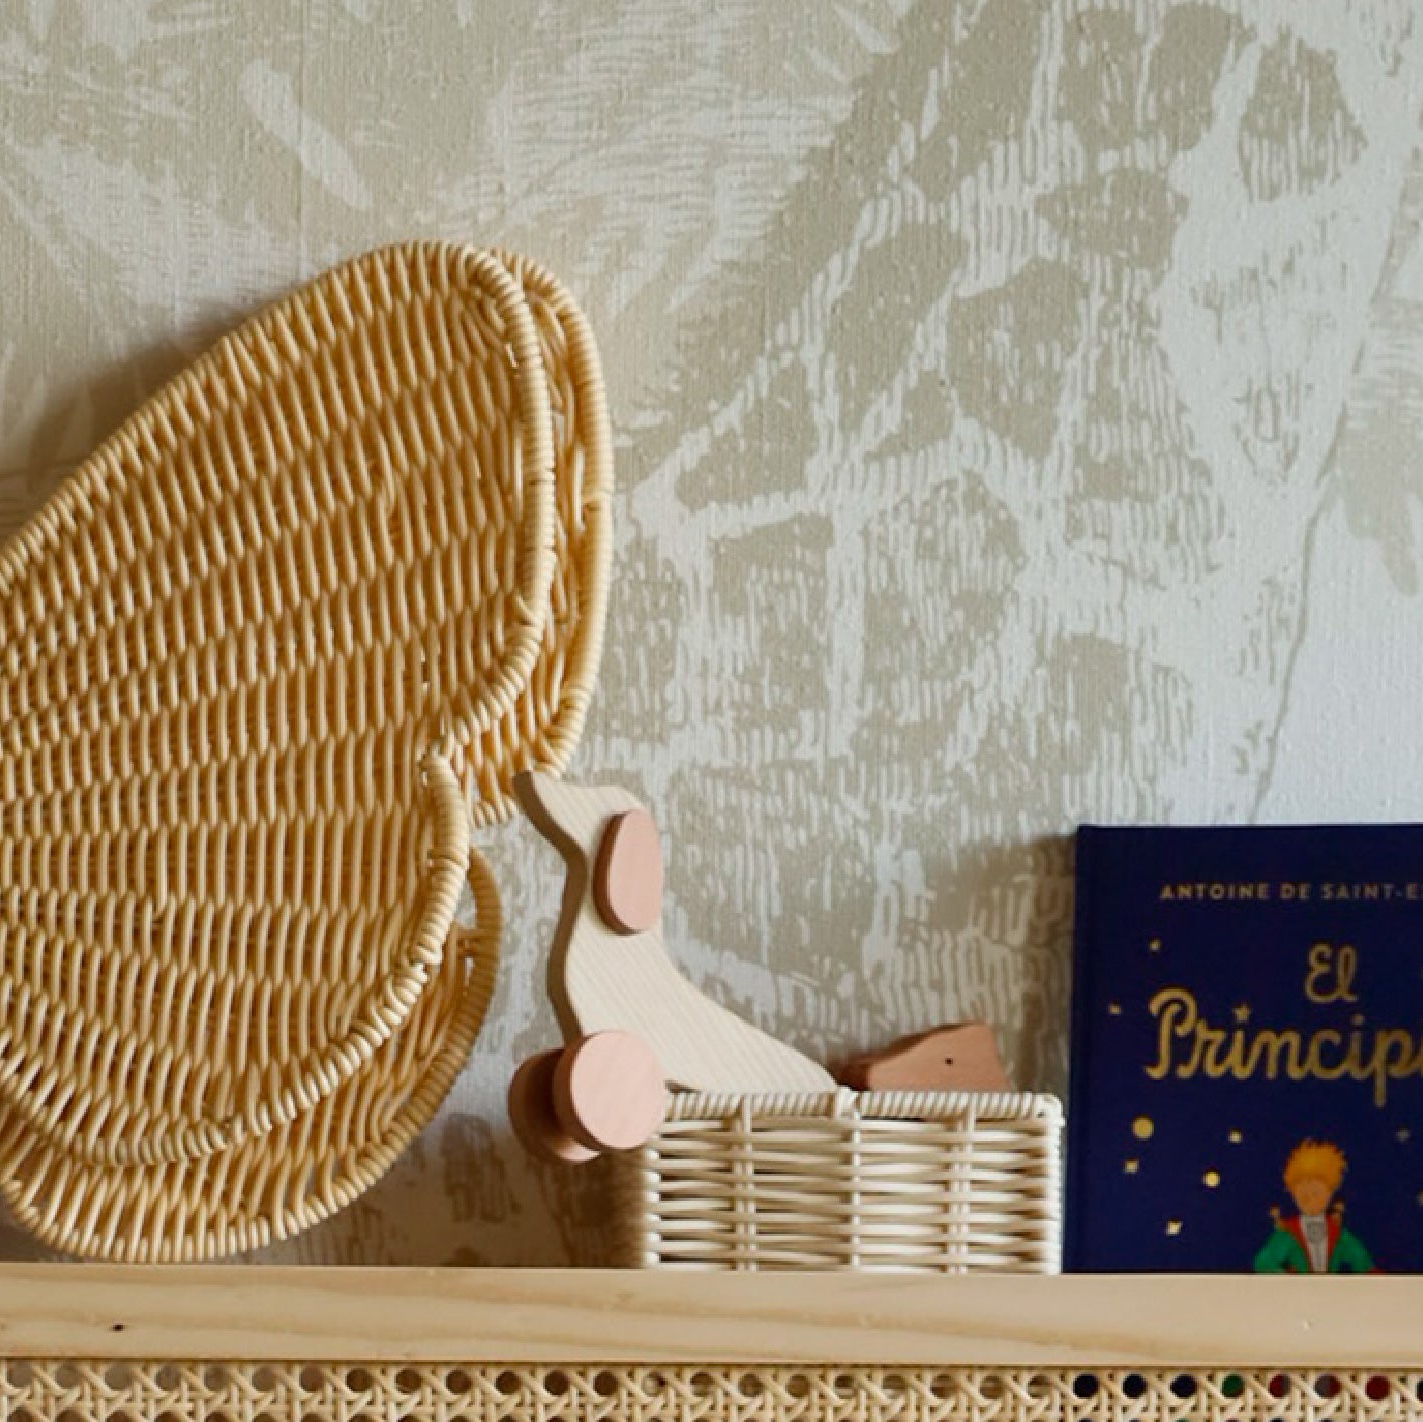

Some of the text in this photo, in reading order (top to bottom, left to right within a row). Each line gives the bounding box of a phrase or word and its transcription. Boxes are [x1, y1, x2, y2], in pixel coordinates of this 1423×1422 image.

[1159, 882, 1270, 900] ANTOINE
[1279, 883, 1311, 900] DE
[1305, 943, 1358, 1003] El
